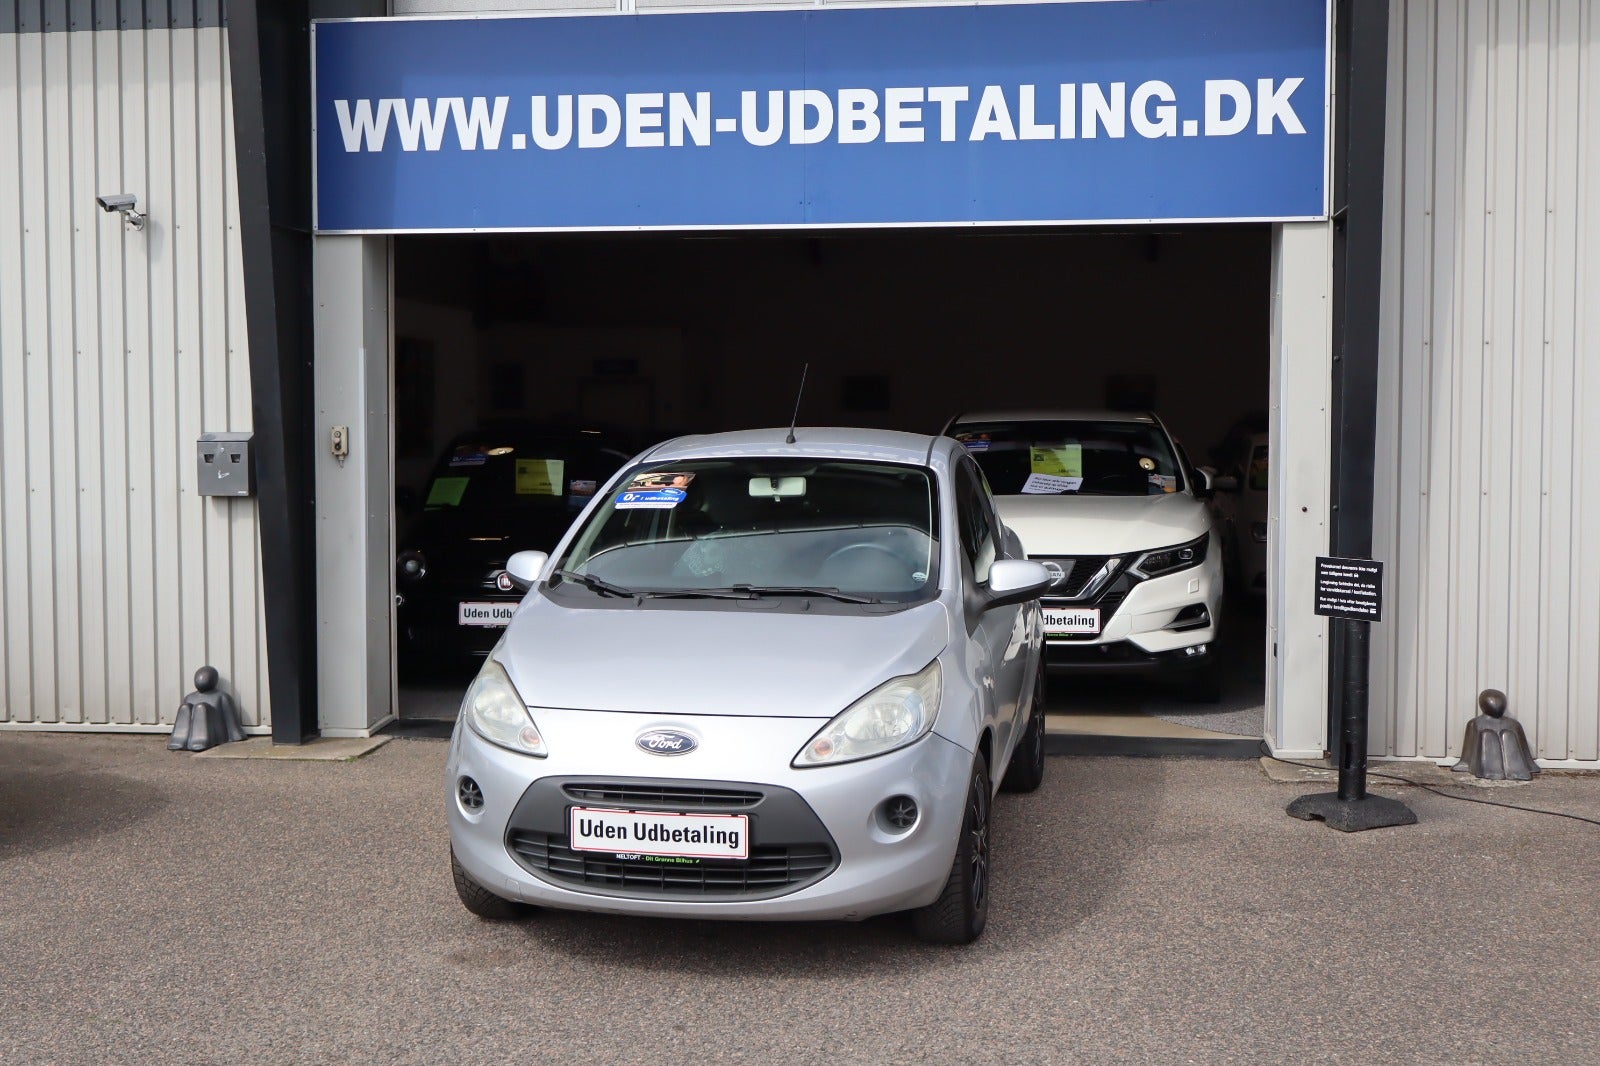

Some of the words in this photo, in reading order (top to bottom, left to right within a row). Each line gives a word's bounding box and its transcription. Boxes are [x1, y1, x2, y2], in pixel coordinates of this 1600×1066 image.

[334, 78, 1306, 152] WWW.UDEN-UDBETALING.DK
[463, 608, 490, 618] Uden
[492, 608, 514, 619] Udb
[648, 733, 684, 749] Ford
[580, 818, 627, 840] Uden
[633, 822, 739, 849] Udbetaling
